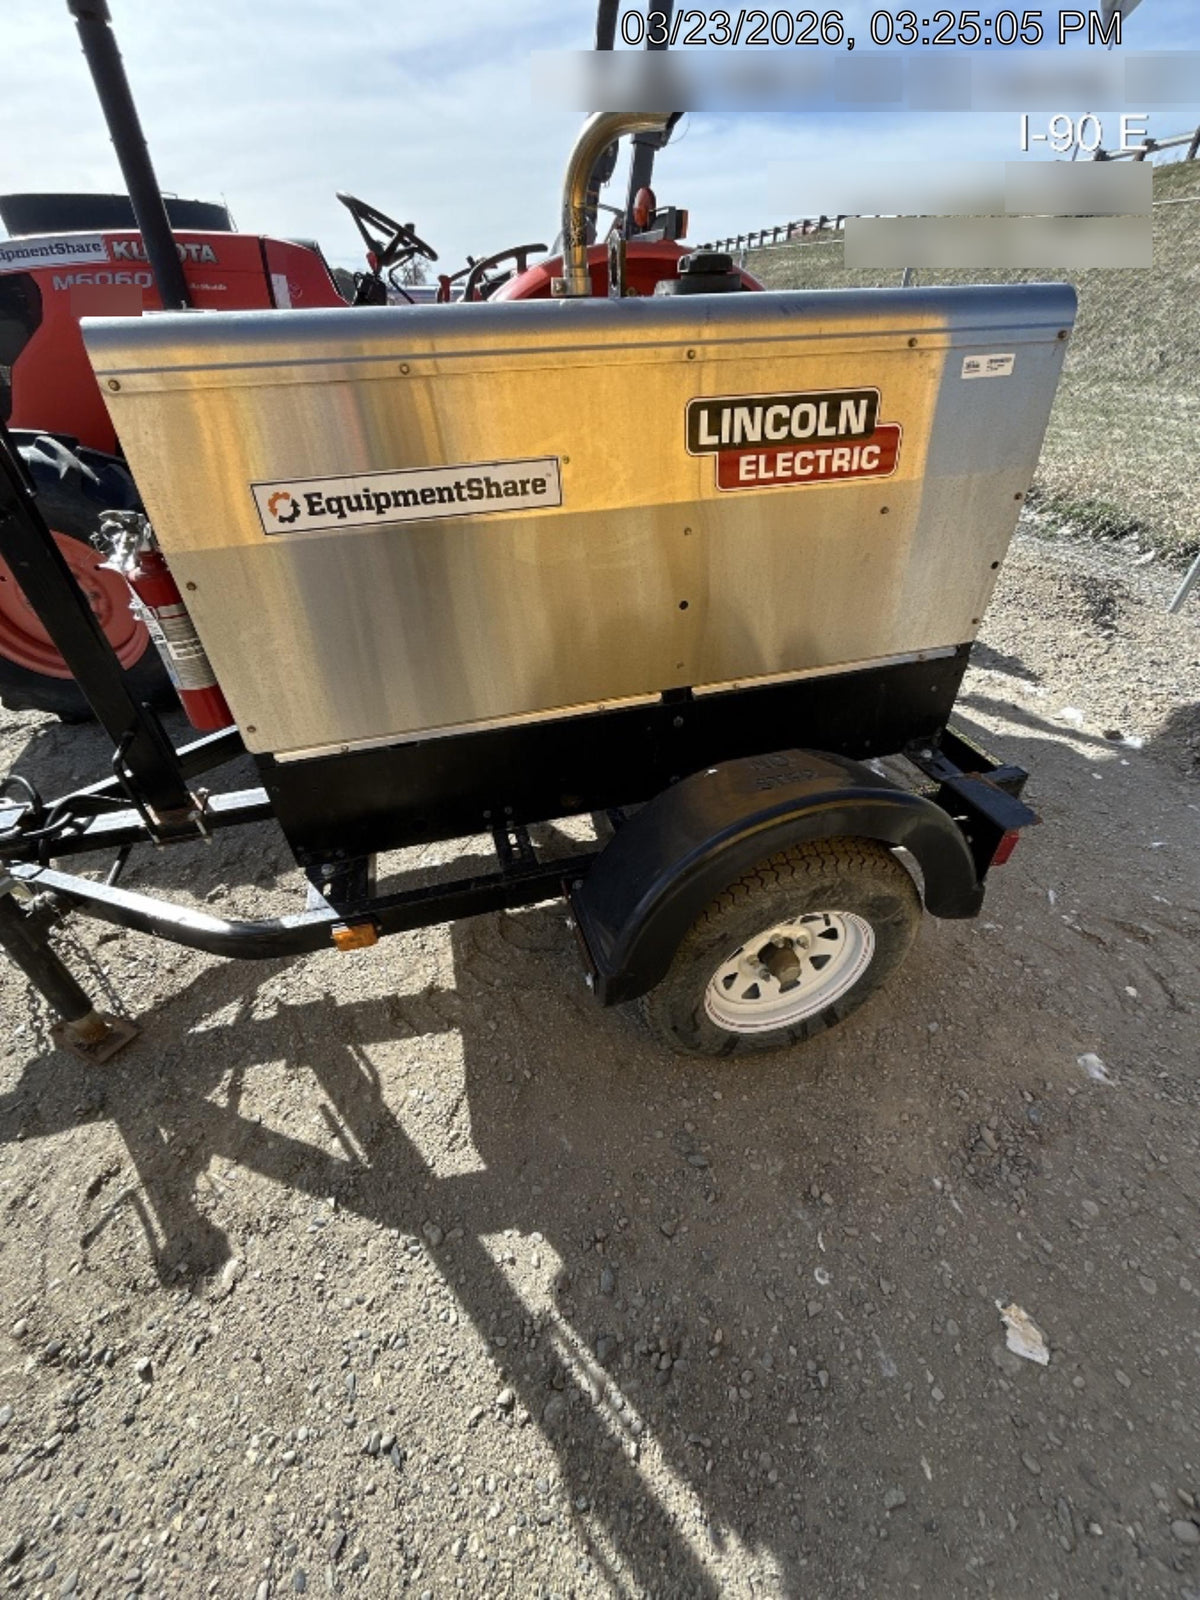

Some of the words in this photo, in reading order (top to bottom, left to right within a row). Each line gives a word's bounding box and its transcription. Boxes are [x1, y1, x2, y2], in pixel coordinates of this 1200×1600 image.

[0, 242, 102, 262] ipmentShare
[112, 241, 218, 263] KUOTA
[698, 399, 868, 445] LINCOLN
[739, 445, 881, 481] ELECTRIC
[303, 476, 547, 519] EquipmentShare
